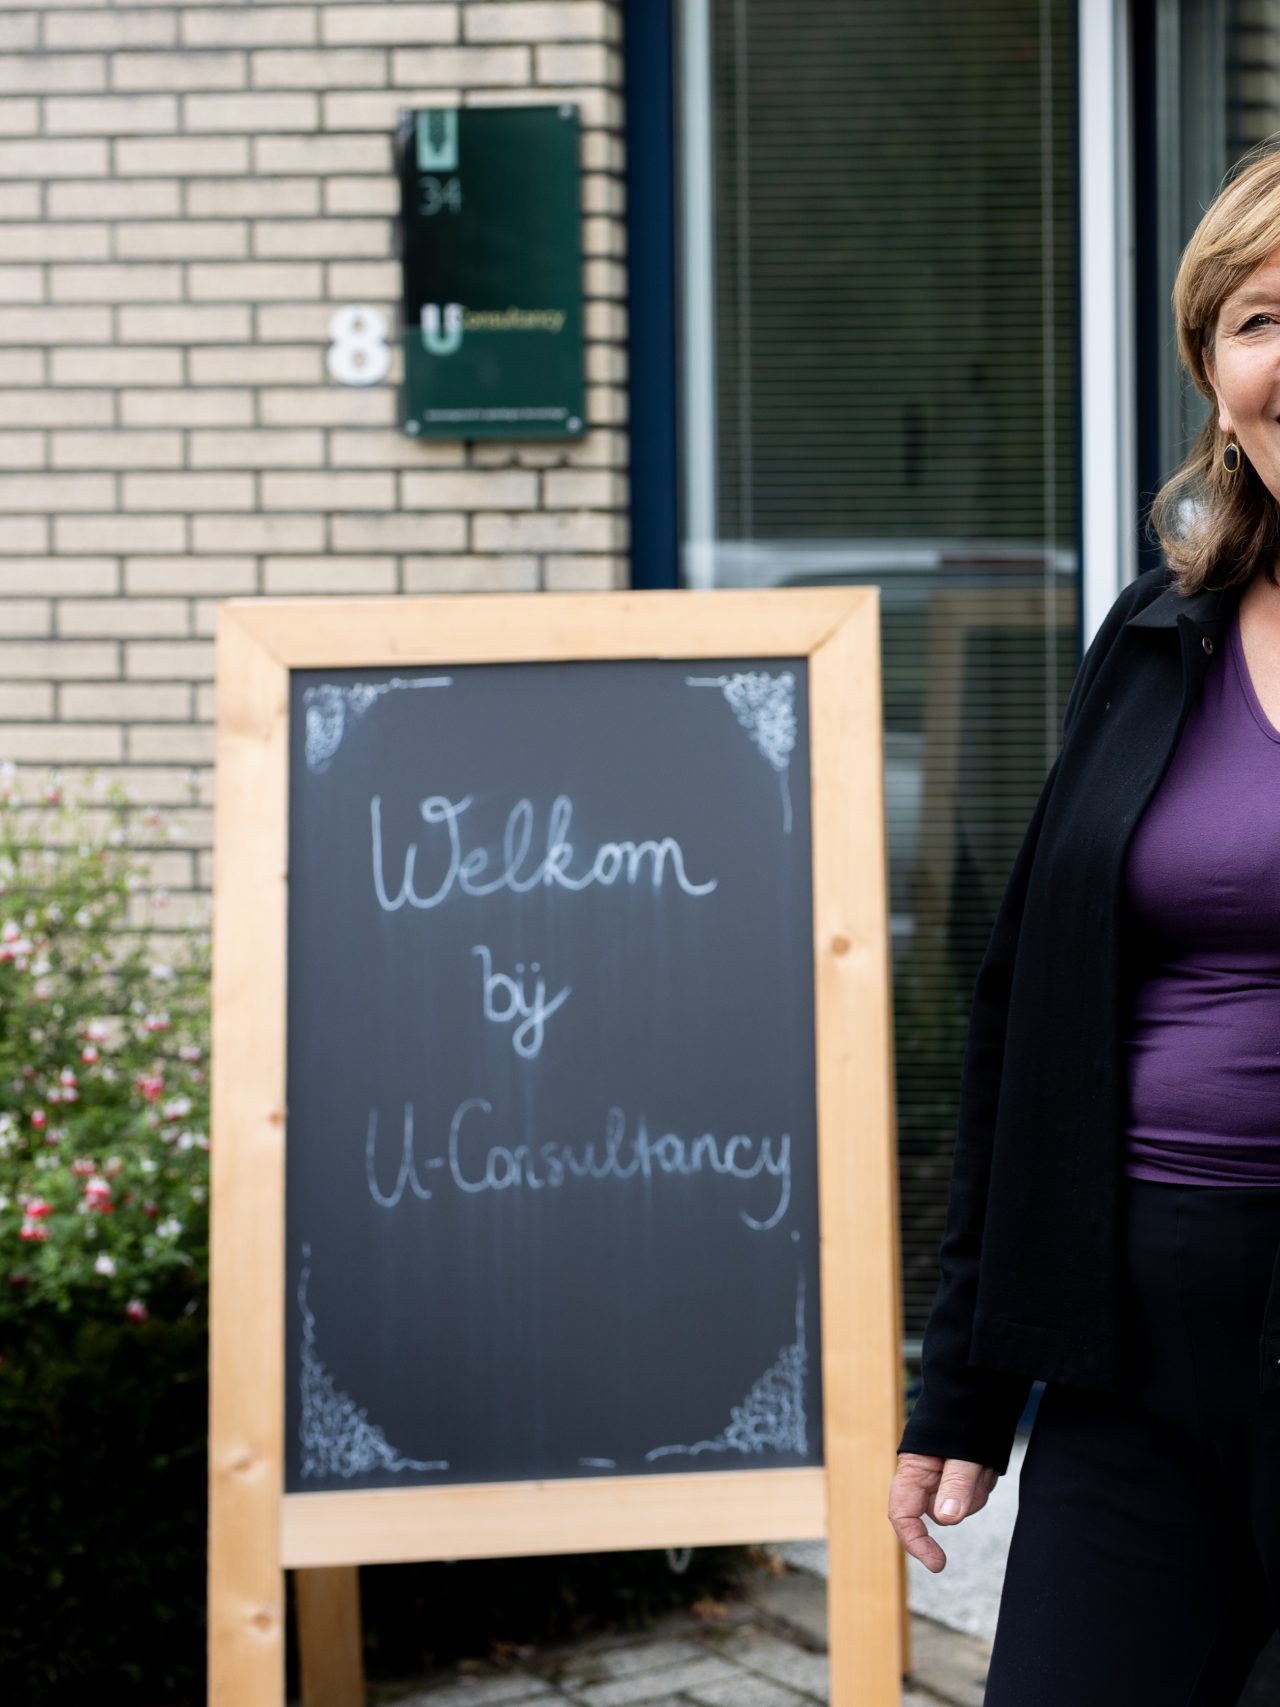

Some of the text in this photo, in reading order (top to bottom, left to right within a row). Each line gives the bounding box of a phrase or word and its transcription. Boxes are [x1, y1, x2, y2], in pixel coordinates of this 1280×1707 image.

[326, 303, 391, 387] 8
[370, 794, 718, 911] Welkom
[365, 1098, 792, 1230] U-Consultancy
